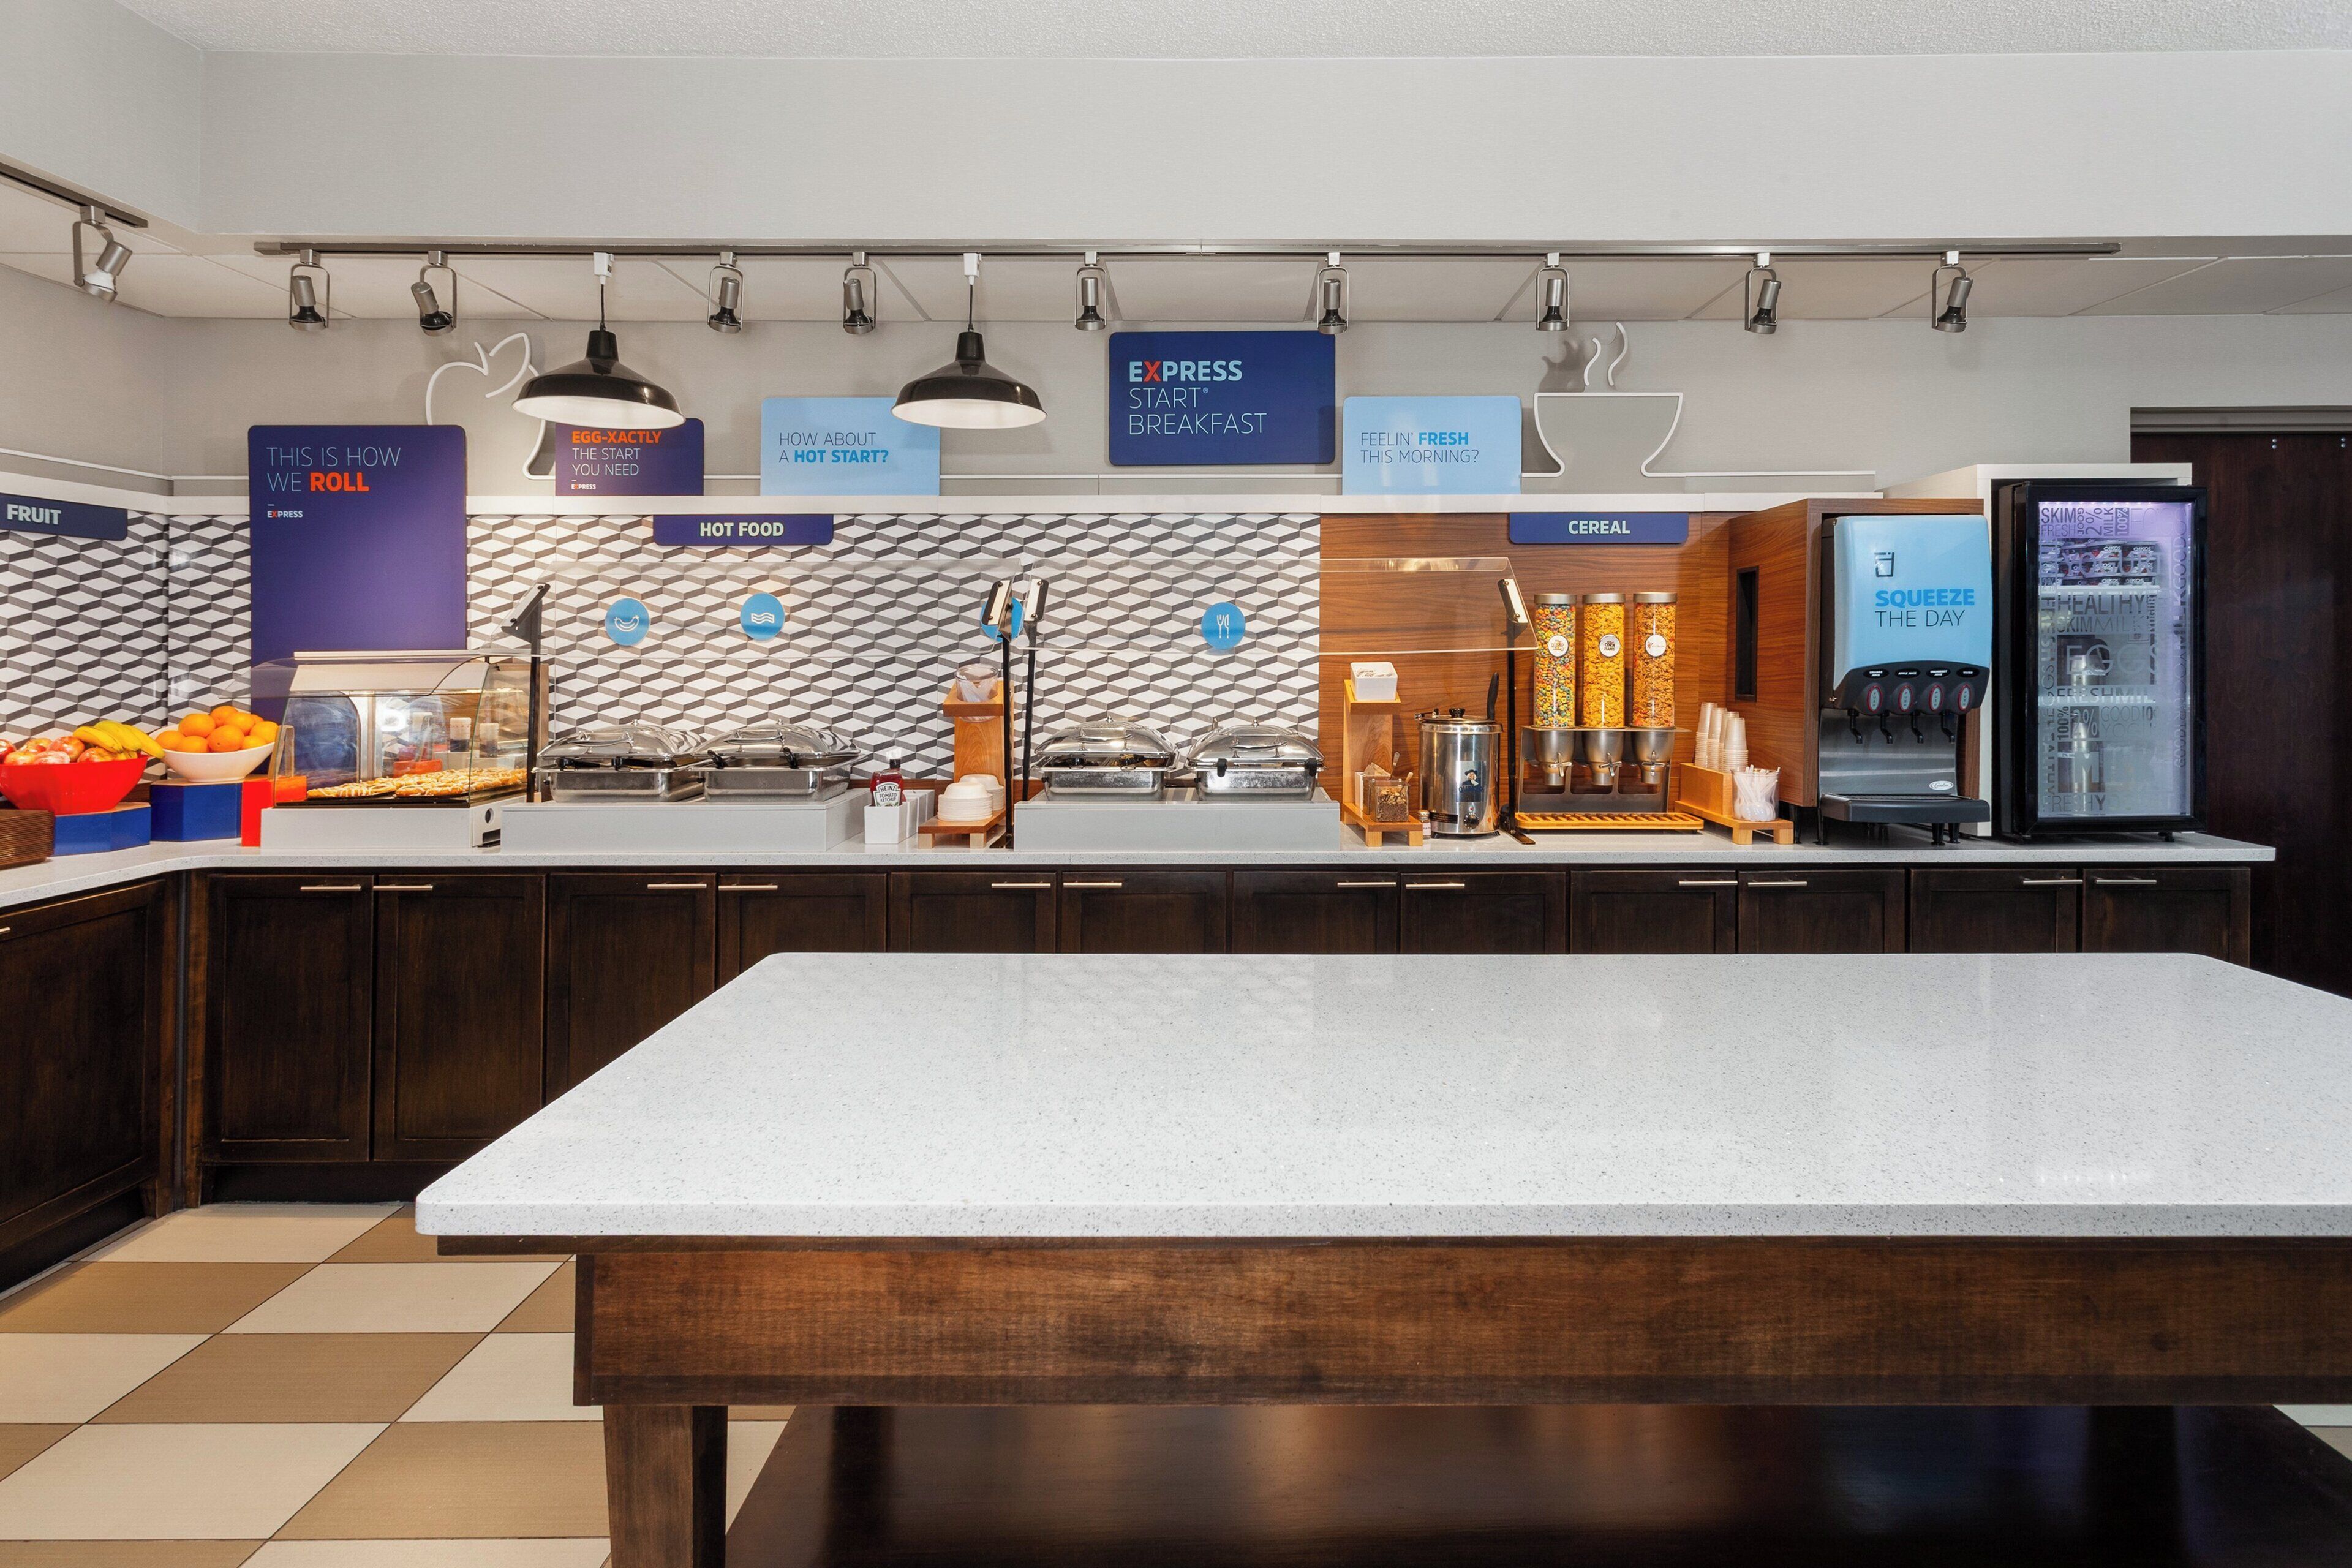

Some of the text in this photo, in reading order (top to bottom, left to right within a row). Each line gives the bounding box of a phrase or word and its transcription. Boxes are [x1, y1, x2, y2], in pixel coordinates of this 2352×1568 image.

[1129, 360, 1242, 382] EXPRESS
[1129, 413, 1267, 435] BREAKFAST
[572, 431, 662, 444] EGG-XACTLY
[779, 432, 876, 446] HOW ABOUT
[1419, 432, 1469, 445] FRESH
[266, 447, 401, 467] THIS IS HOW
[572, 448, 641, 460] THE START
[779, 450, 889, 463] A HOT START?
[1361, 450, 1479, 464] THIS MORNING?
[572, 464, 639, 476] YOU NEED
[267, 472, 370, 492] WE ROLL
[7, 504, 62, 525] FRUIT
[2041, 508, 2076, 523] SKIM
[2086, 508, 2102, 535] 2%
[2103, 508, 2113, 536] MILK
[2116, 508, 2128, 536] 100%
[700, 522, 784, 537] HOT FOOD
[1568, 521, 1630, 535] CEREAL
[2041, 524, 2076, 537] FRESH
[1875, 589, 1975, 608] SQUEEZE
[2057, 592, 2146, 614] HEALTHY
[1875, 610, 1966, 627] THE DAY
[2101, 706, 2140, 722] GOOD
[2057, 706, 2069, 740] 100%
